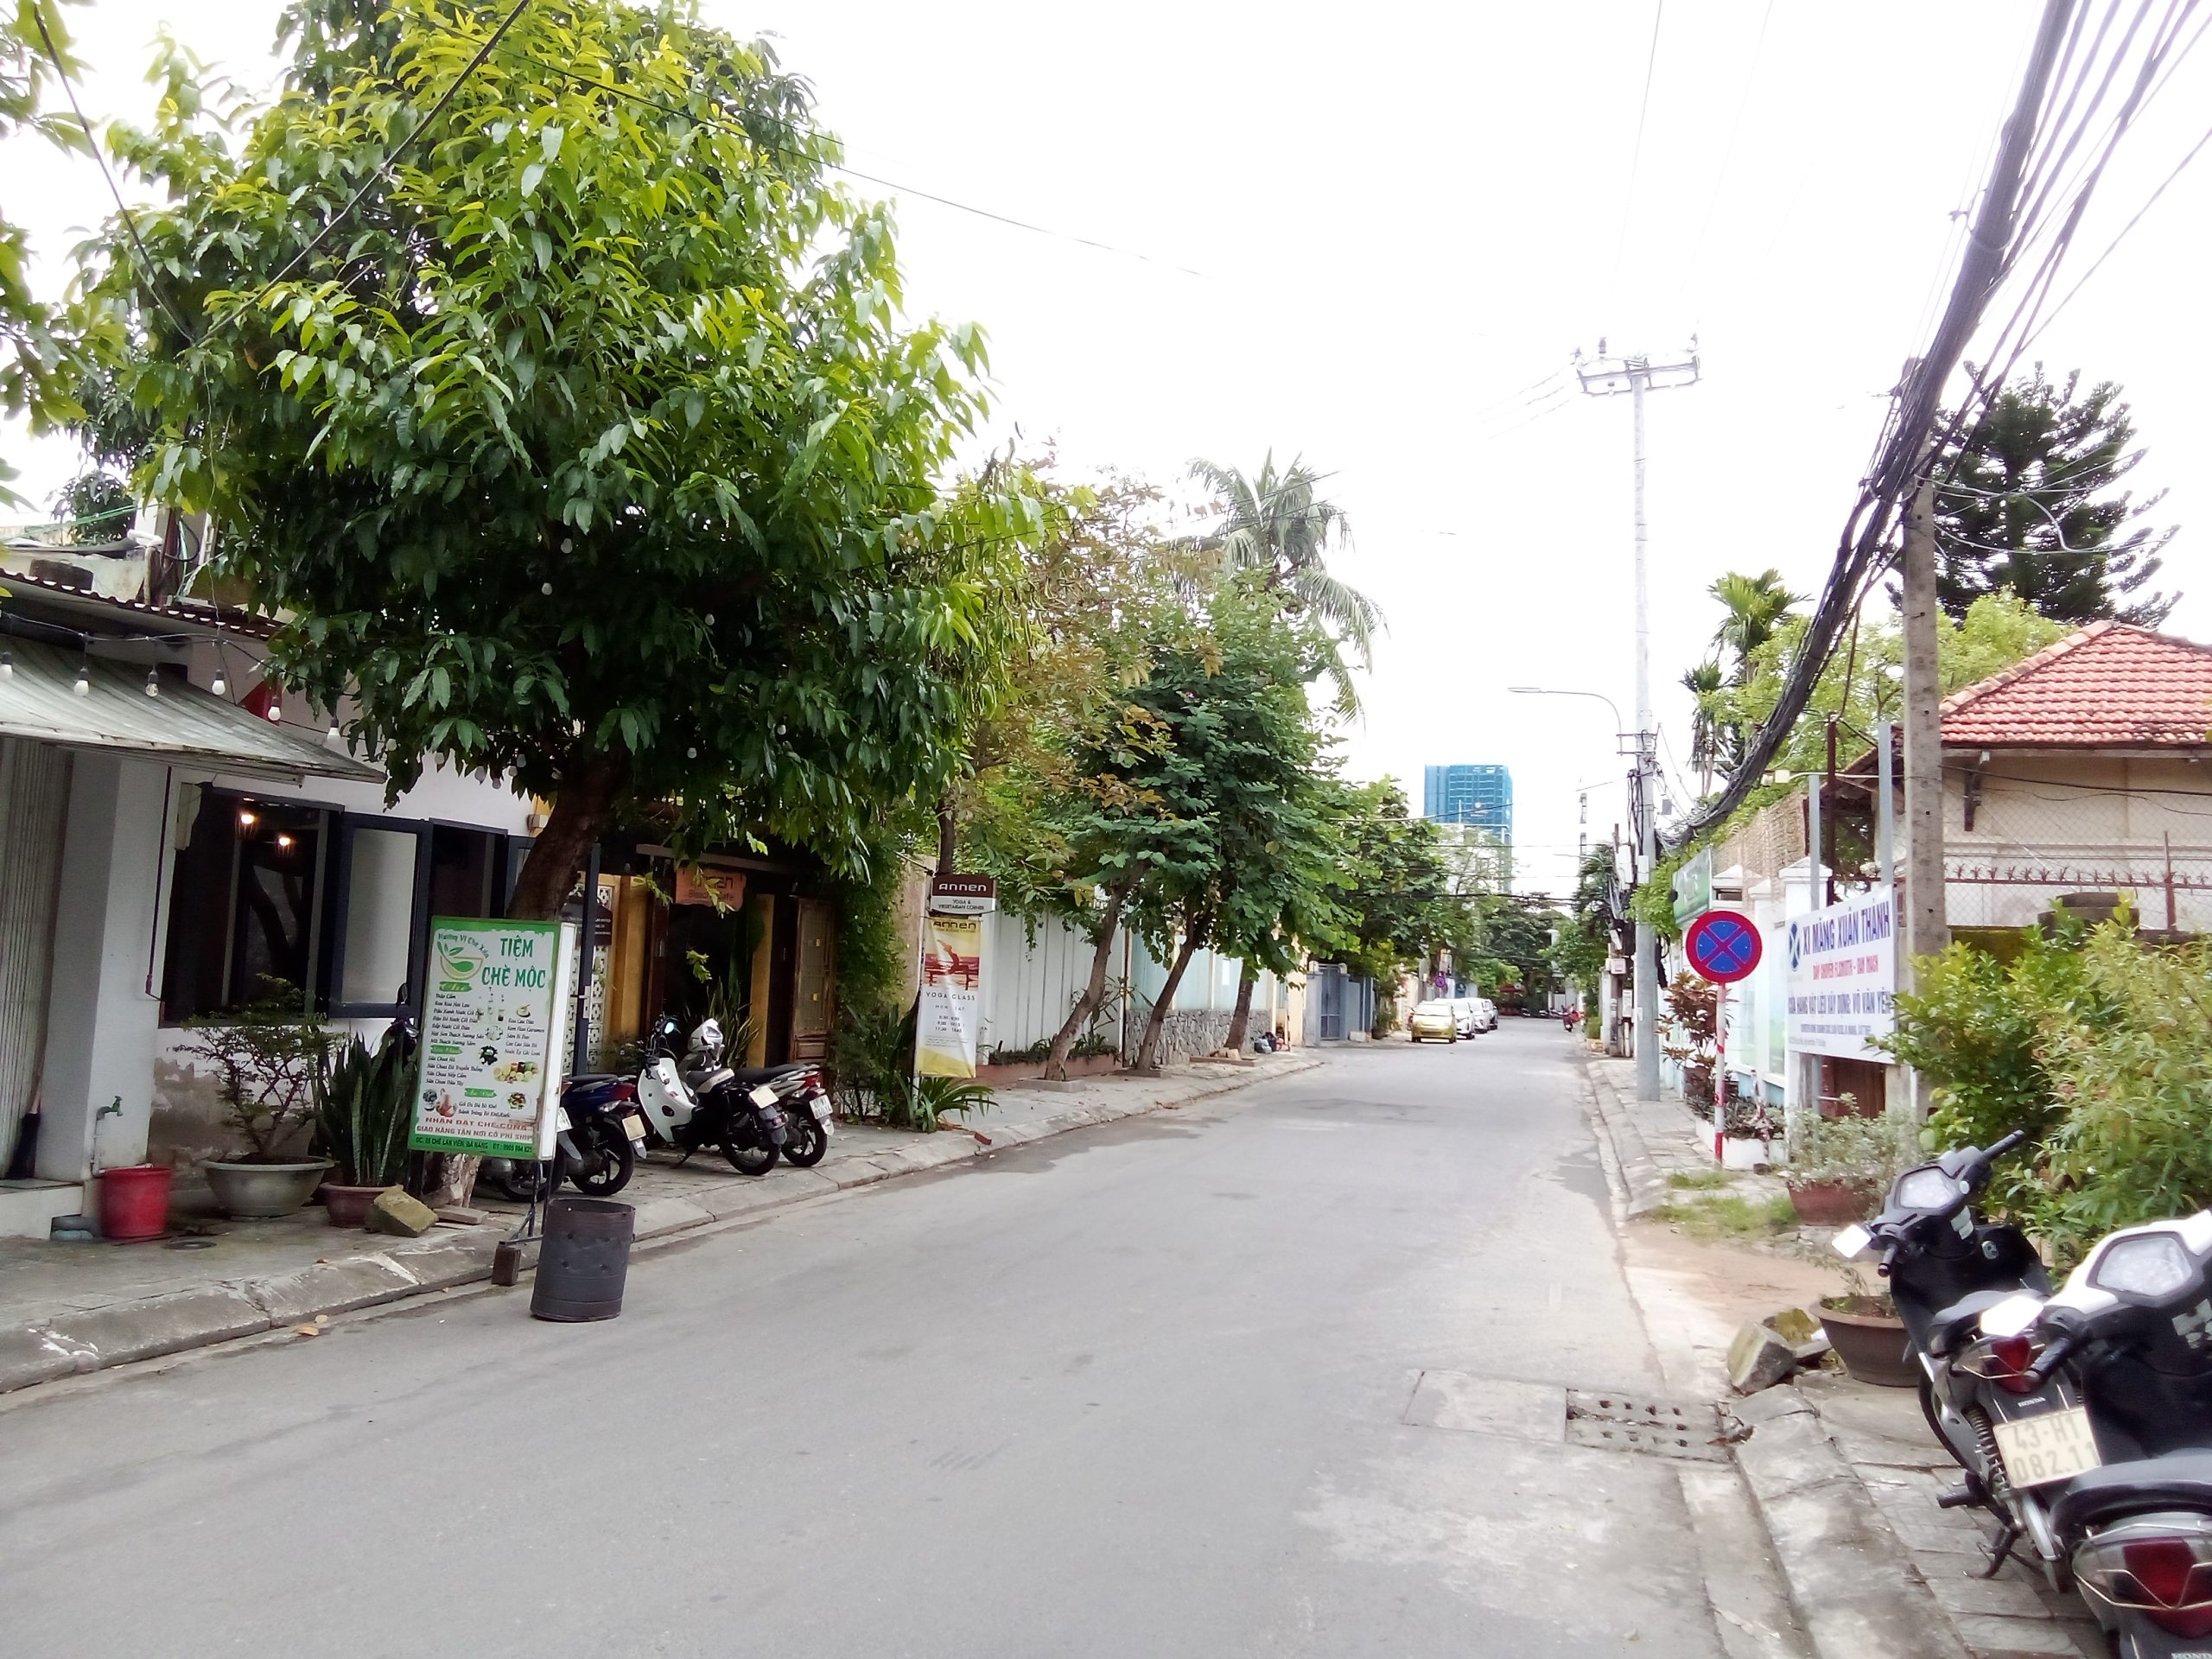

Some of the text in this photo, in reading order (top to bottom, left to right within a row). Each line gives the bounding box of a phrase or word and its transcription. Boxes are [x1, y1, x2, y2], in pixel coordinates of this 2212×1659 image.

[500, 935, 534, 961] TIỆM
[1803, 925, 1810, 956] XI
[481, 964, 546, 992] CHÈ MỘC
[2018, 1396, 2046, 1408] HONDA
